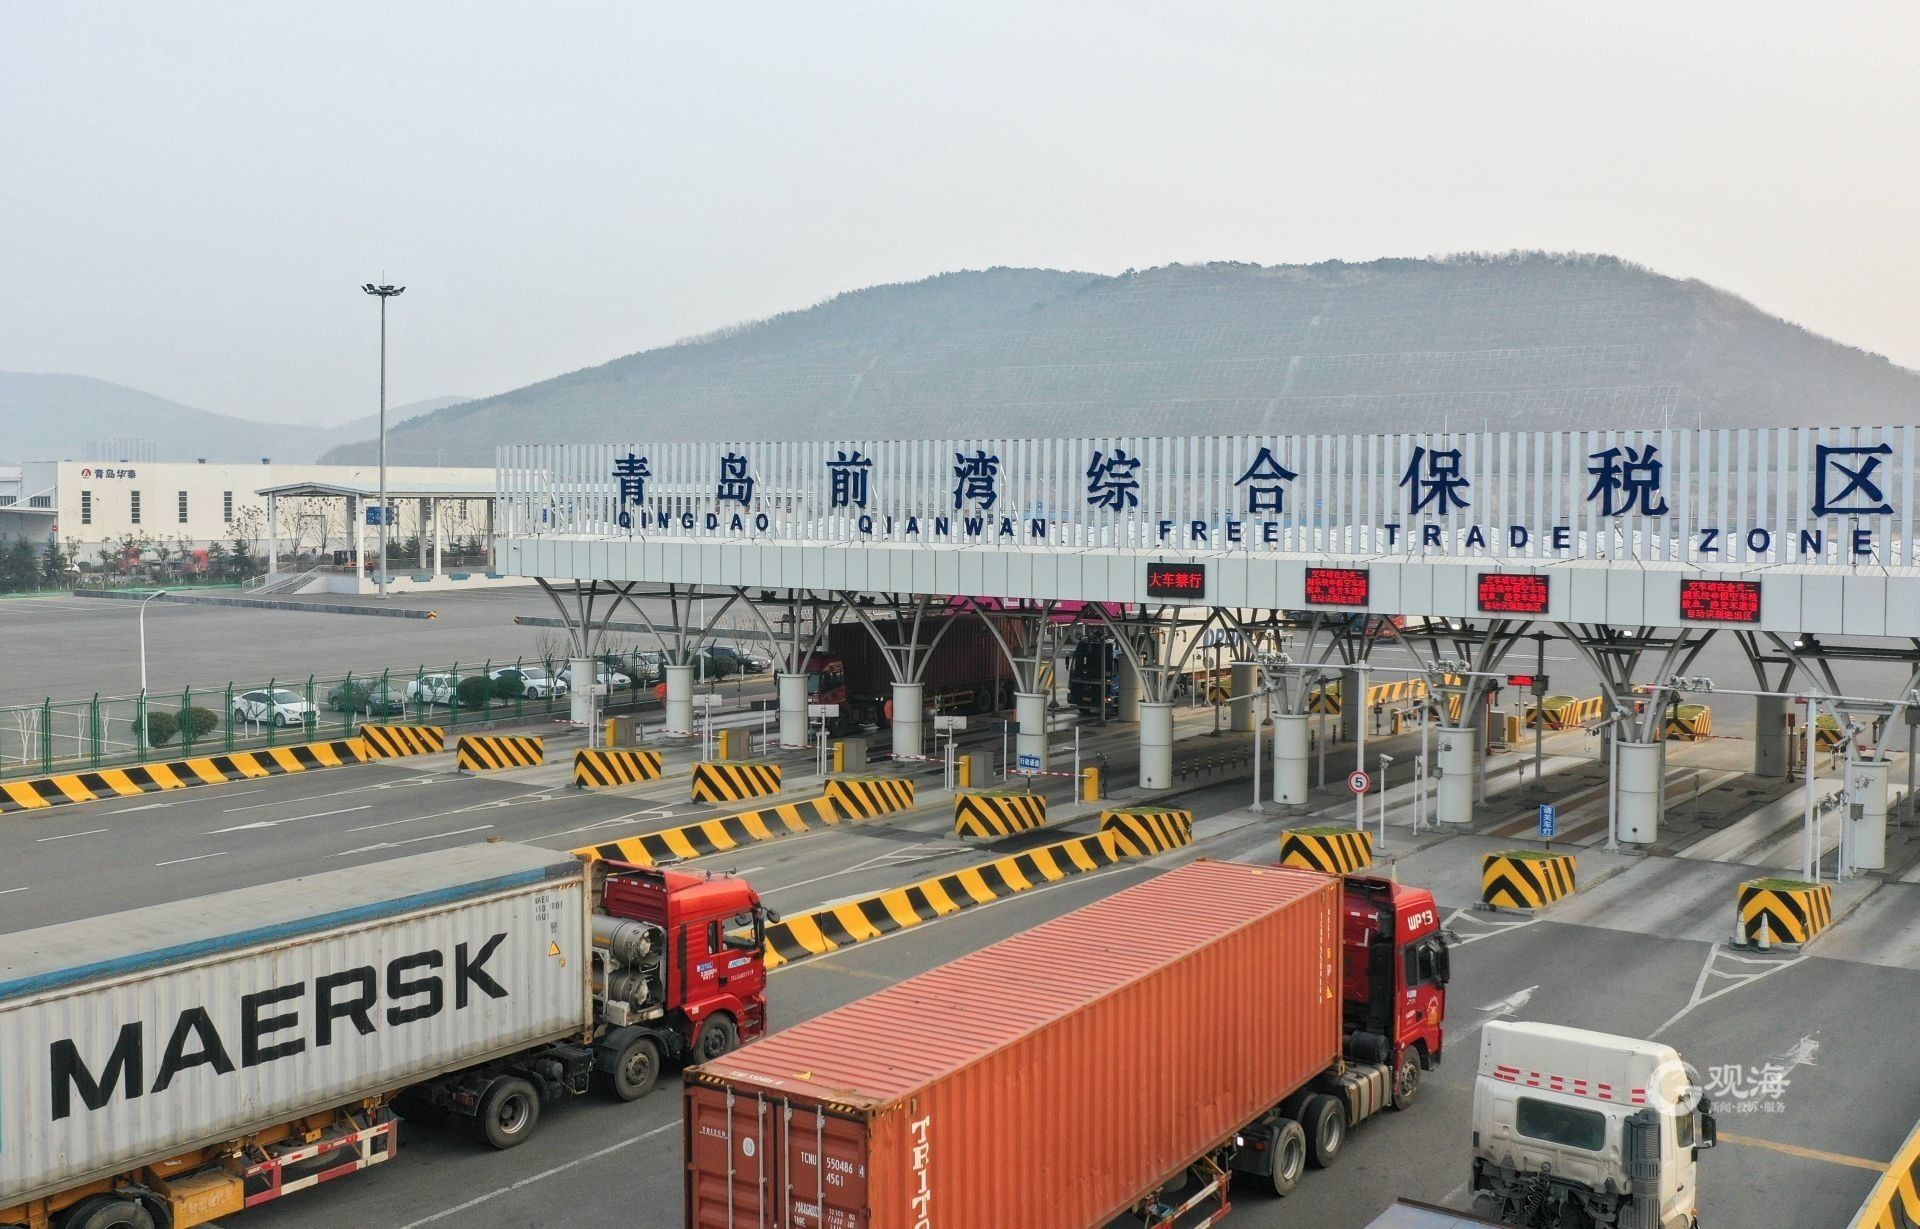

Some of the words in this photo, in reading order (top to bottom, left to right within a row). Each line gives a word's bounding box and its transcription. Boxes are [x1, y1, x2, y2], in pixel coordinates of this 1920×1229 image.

[612, 443, 1895, 518] 青岛前湾综合保税区
[618, 511, 769, 531] QINGDAO
[858, 514, 1047, 538] QIANWAN
[1159, 520, 1279, 543] FREE
[1384, 523, 1571, 549] TRADE
[1699, 528, 1873, 555] ZONE
[1149, 572, 1202, 588] 大车禁行
[1354, 776, 1363, 788] 5
[1407, 909, 1434, 931] WP13
[50, 932, 509, 1122] MAERSK
[801, 1151, 817, 1166] TCNU
[826, 1157, 853, 1174] 550486
[858, 1164, 866, 1179] 4
[826, 1172, 844, 1187] 45G1
